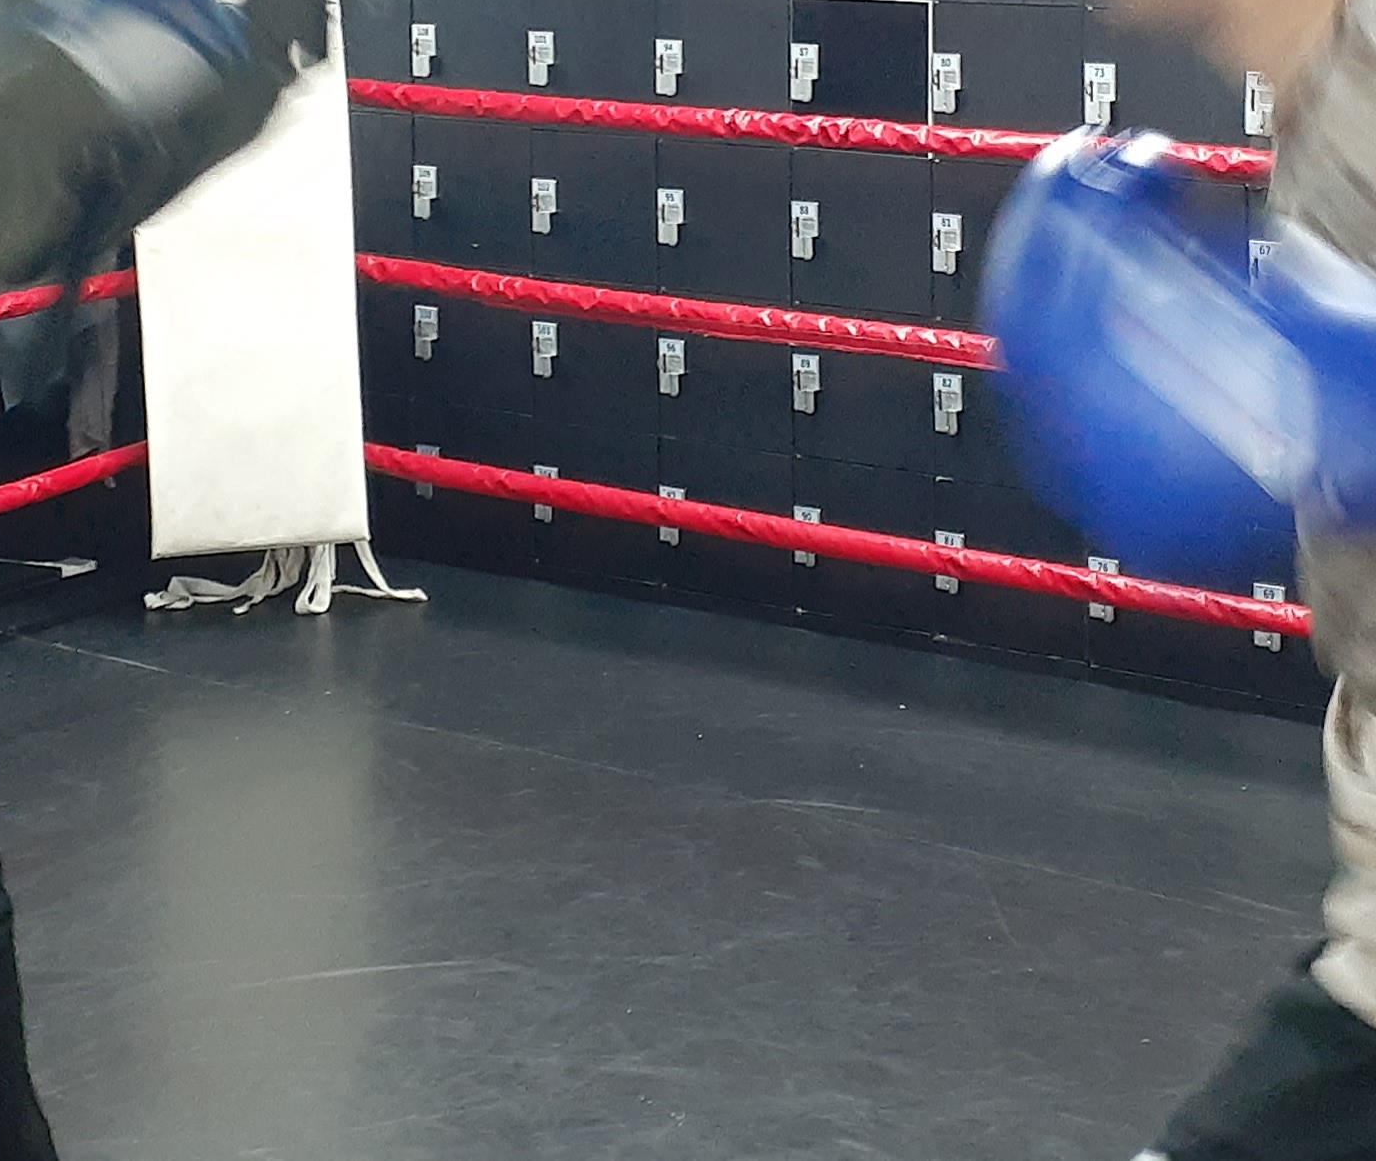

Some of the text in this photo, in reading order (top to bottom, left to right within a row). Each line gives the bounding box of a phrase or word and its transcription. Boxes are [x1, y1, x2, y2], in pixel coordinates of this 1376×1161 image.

[663, 43, 674, 52] 94
[940, 58, 951, 67] 80
[1094, 67, 1105, 78] 73
[942, 218, 951, 227] 81
[1259, 245, 1271, 256] 67
[666, 342, 676, 352] 96
[800, 359, 811, 368] 89
[942, 378, 952, 388] 82
[1263, 589, 1275, 600] 69
